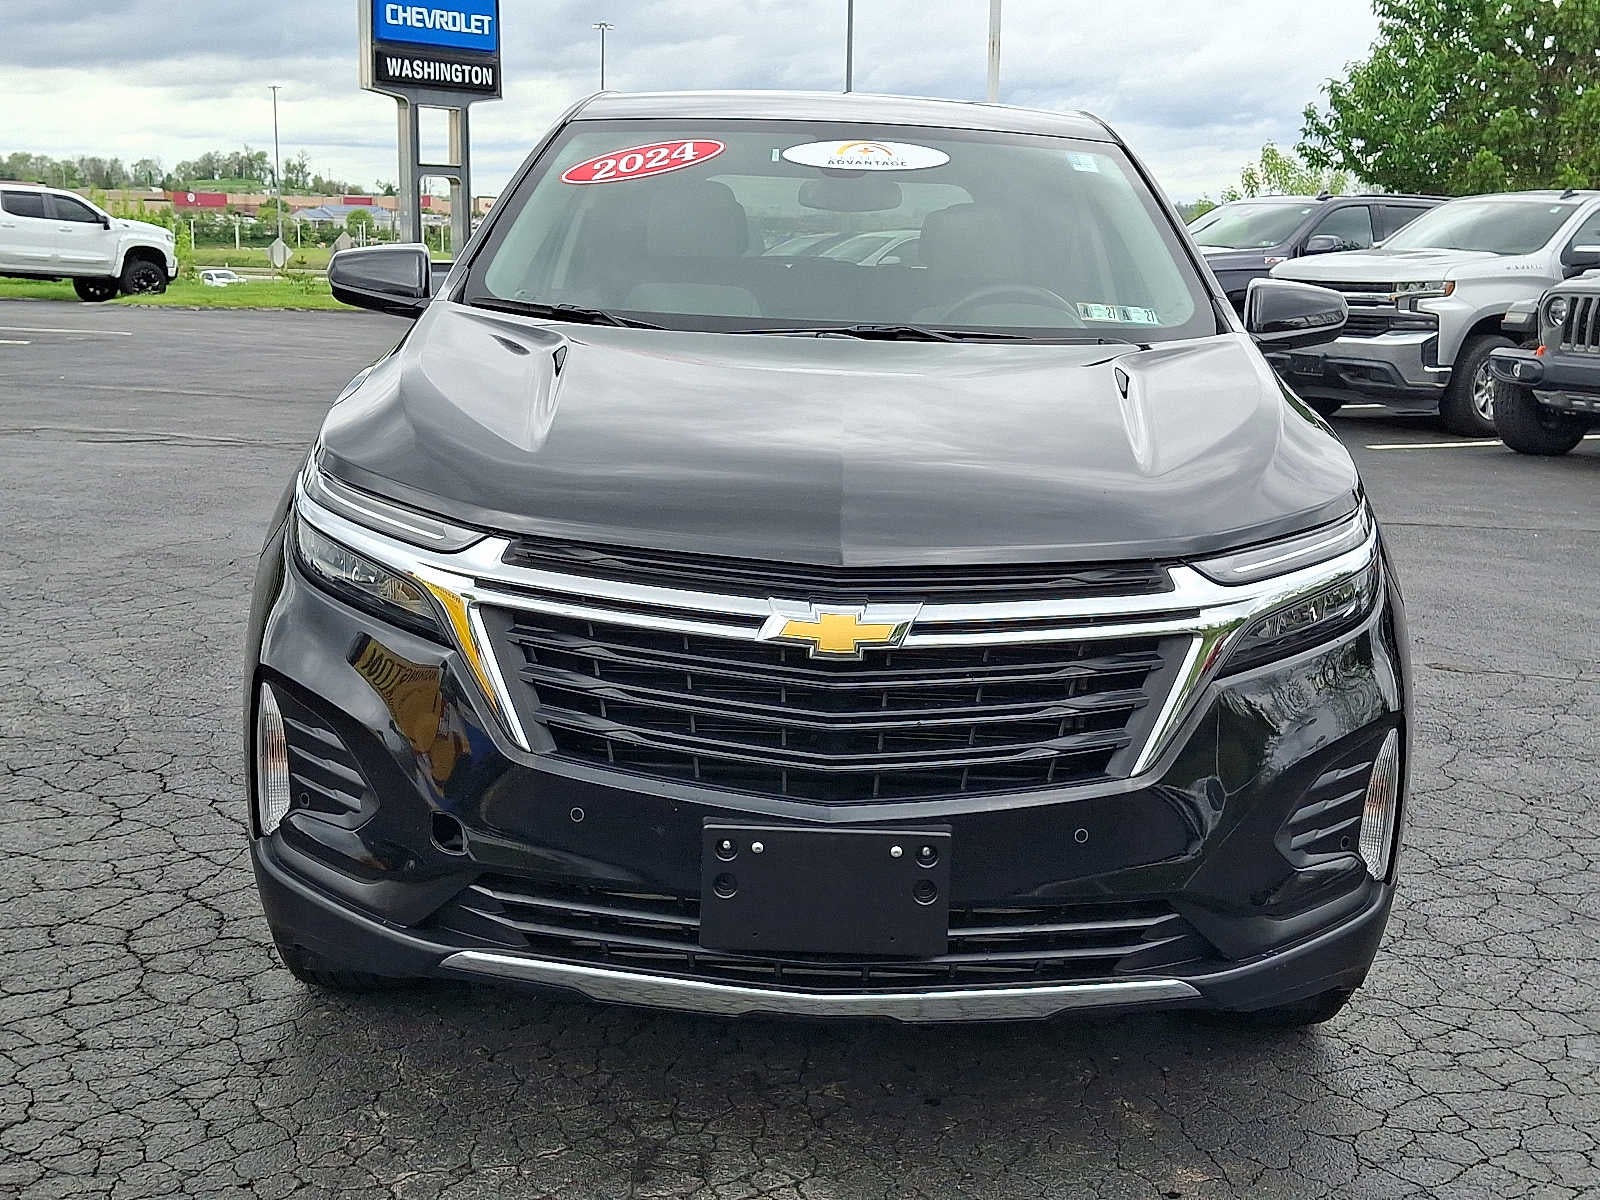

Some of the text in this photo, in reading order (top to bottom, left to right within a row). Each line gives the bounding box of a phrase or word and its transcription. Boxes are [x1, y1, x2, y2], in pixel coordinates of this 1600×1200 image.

[385, 3, 492, 35] CHEVROLET
[386, 57, 492, 86] WASHINGTON
[591, 141, 699, 181] 2024
